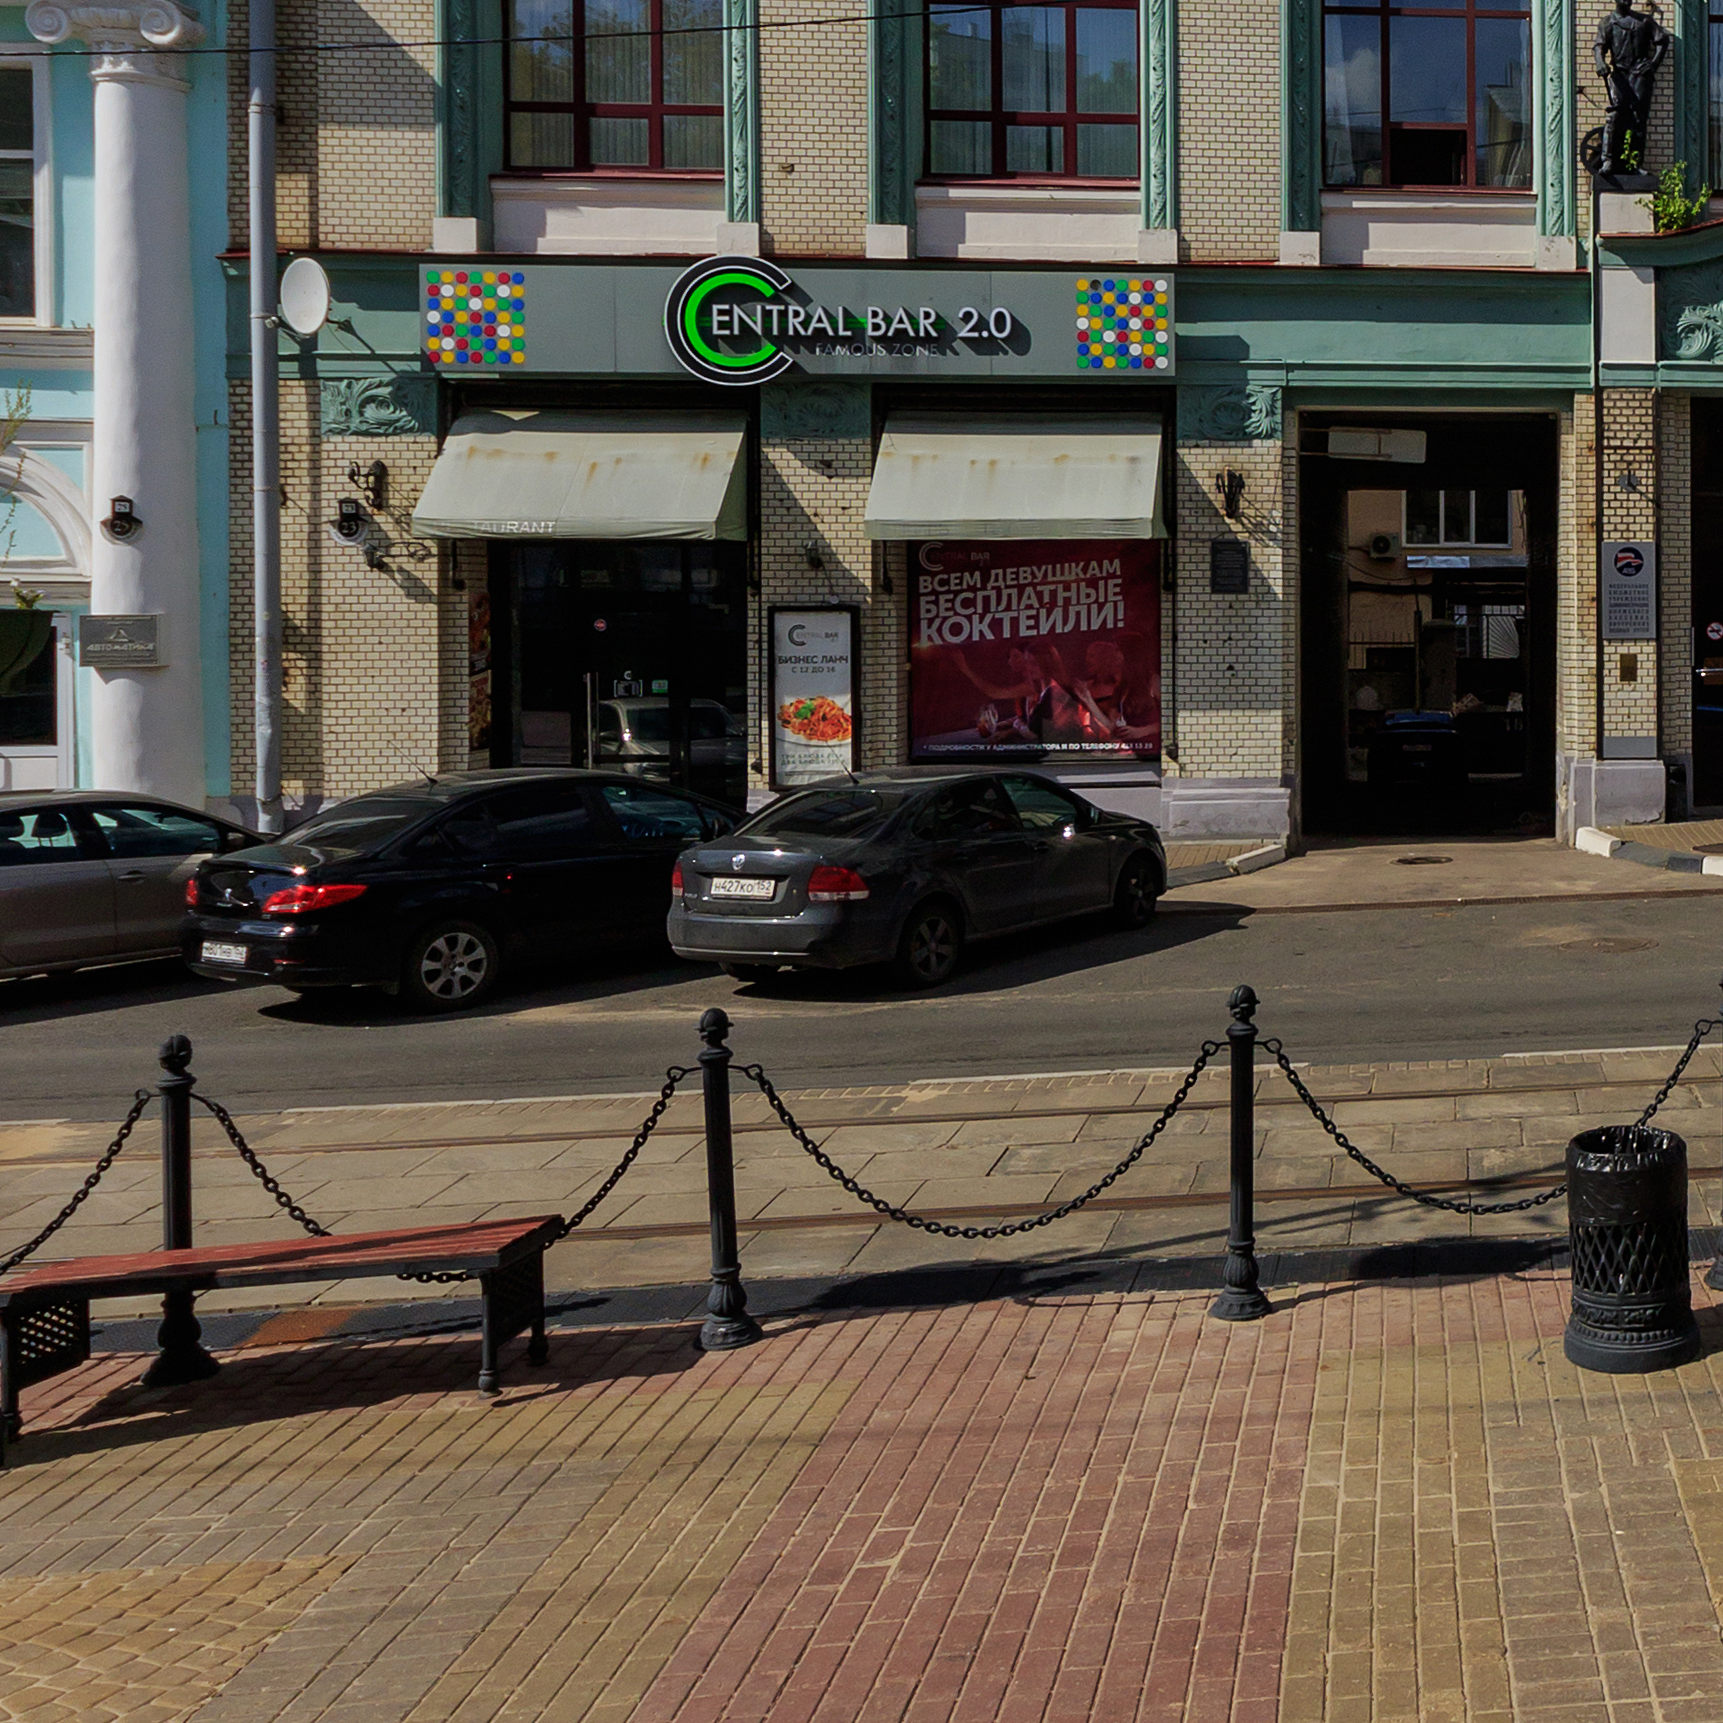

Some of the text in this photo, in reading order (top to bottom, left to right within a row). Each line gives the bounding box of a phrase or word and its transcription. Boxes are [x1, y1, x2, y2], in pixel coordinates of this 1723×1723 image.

[664, 255, 1012, 386] CENTRAL BAR 2.0
[815, 343, 939, 357] FAMOUS ZONE
[341, 521, 357, 534] 23
[970, 552, 990, 561] BAR
[918, 558, 1121, 594] ВСЕМ ДЕВУШКАМ
[919, 578, 1124, 619] БЕСПЛАТНЫЕ
[86, 643, 155, 651] АВТОМАТИКА
[778, 655, 849, 665] БИЗНЕС ЛАНЧ
[811, 666, 825, 674] ДО
[757, 881, 772, 891] 152
